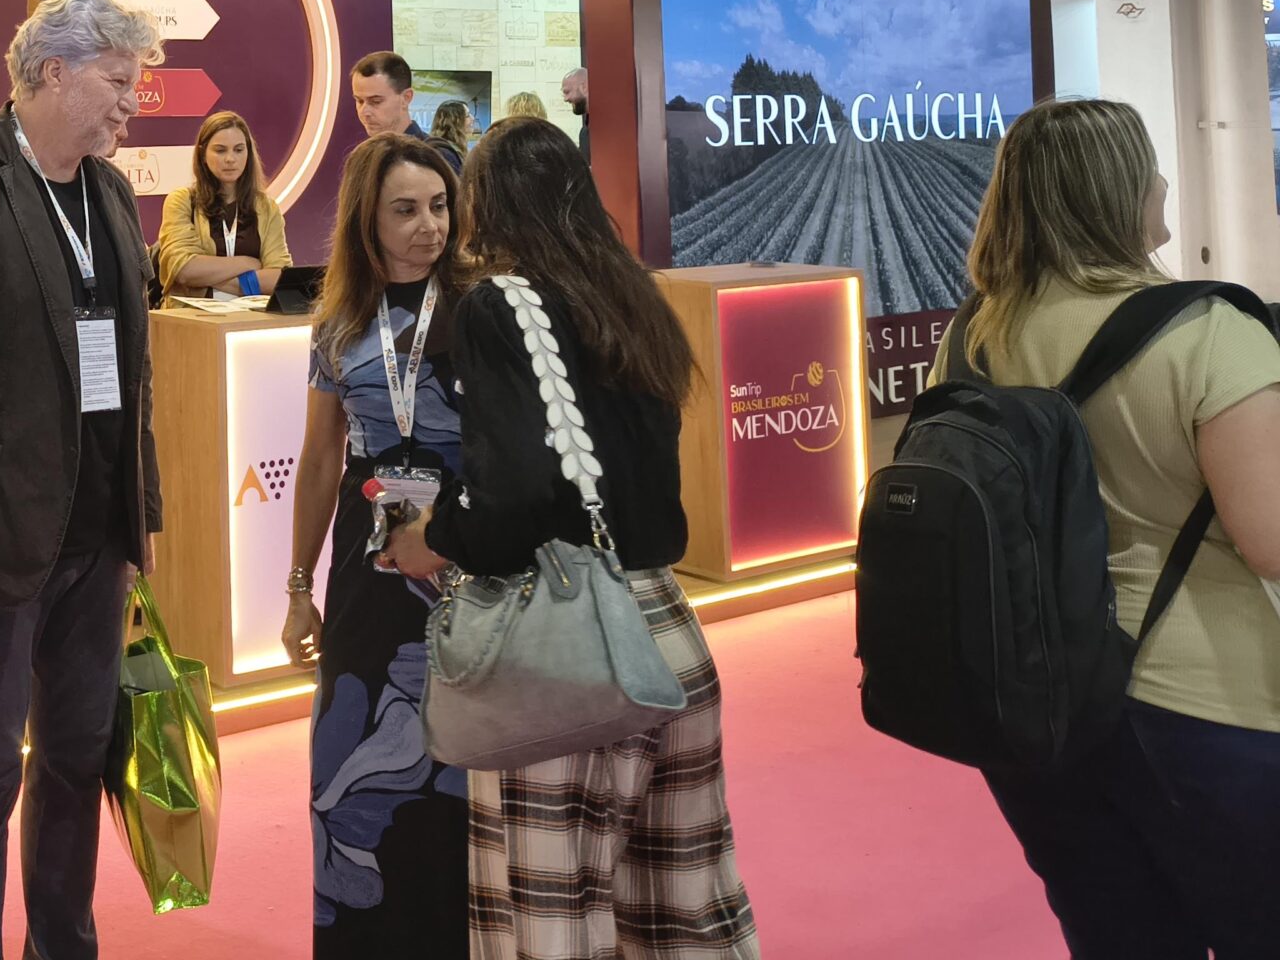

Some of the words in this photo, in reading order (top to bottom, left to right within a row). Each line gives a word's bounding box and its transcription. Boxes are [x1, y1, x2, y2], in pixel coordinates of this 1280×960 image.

[705, 93, 837, 147] SERRA
[851, 80, 1006, 143] GAÚCHA
[731, 395, 793, 413] BRASILEIROS
[795, 392, 809, 405] EM
[732, 403, 839, 442] MENDOZA
